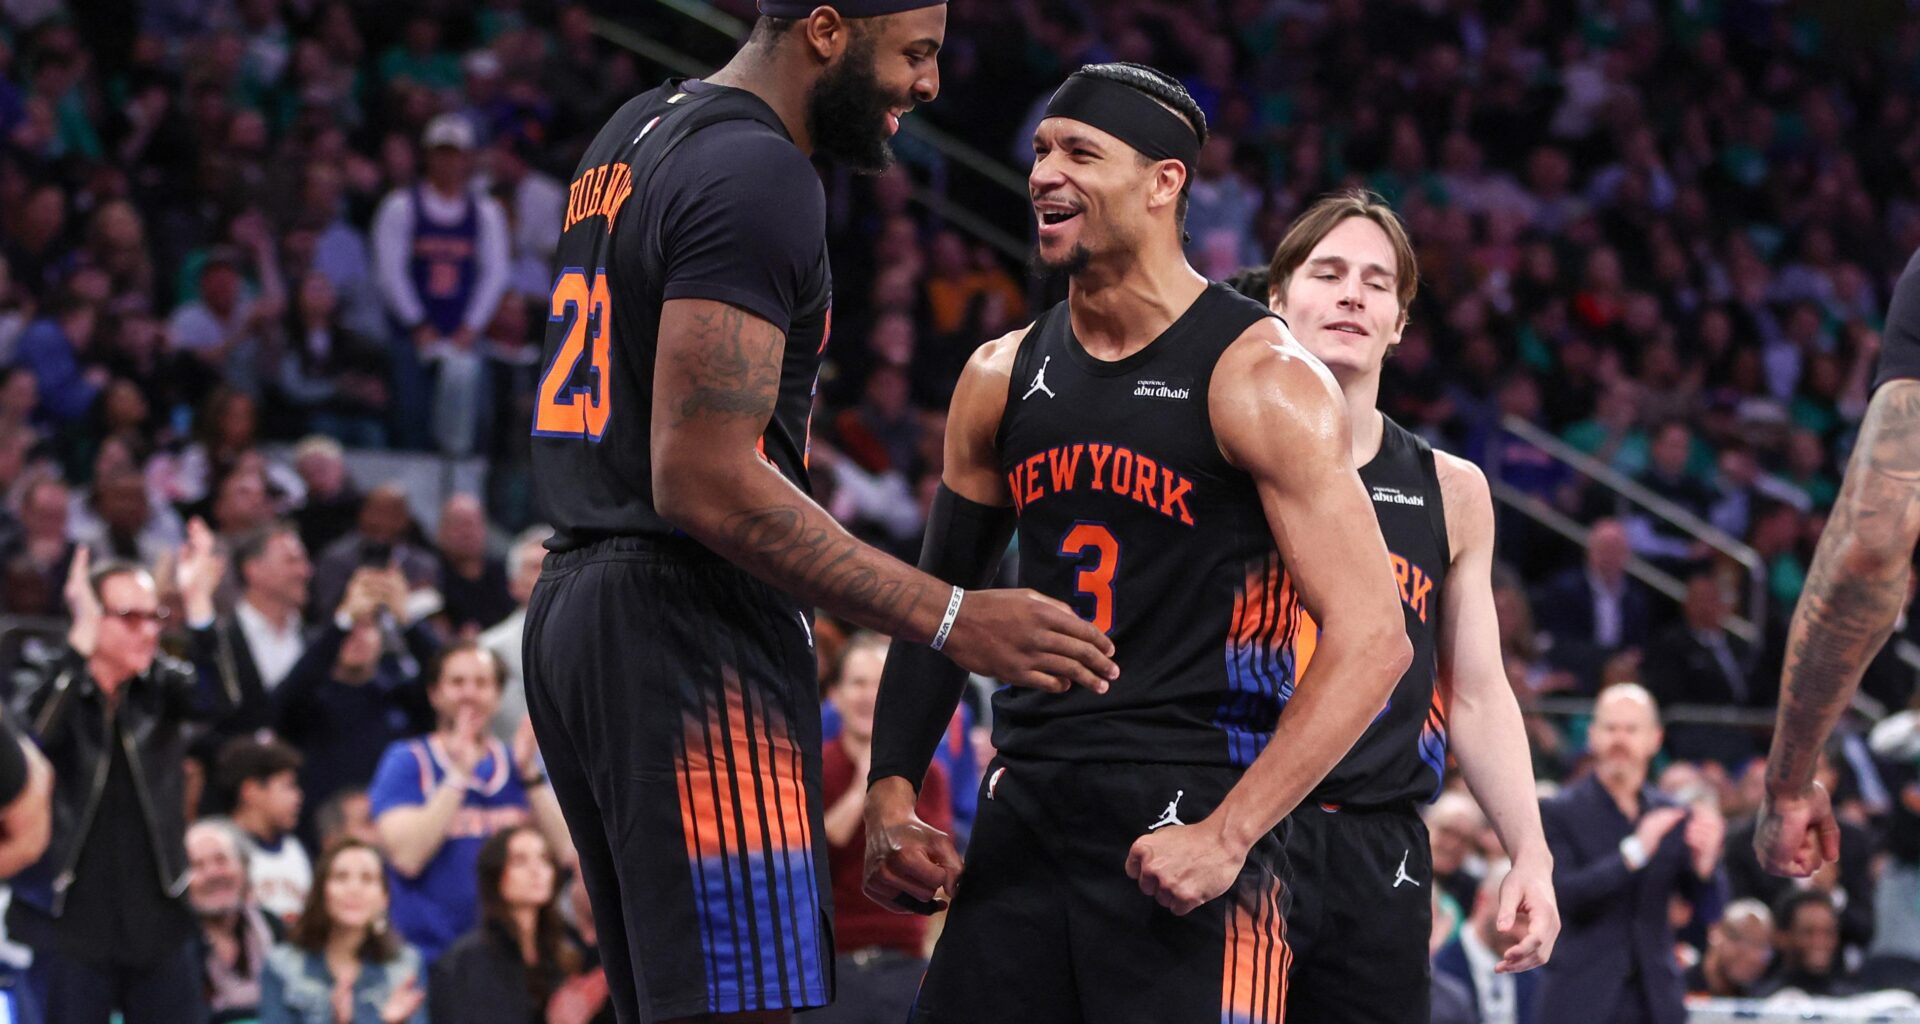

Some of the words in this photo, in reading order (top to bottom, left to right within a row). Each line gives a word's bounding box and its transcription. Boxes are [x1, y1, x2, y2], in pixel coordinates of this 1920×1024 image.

[531, 266, 613, 442] 23
[1133, 386, 1155, 396] abu
[1155, 386, 1190, 399] dhabi
[1008, 444, 1083, 517] NEW
[1088, 443, 1195, 527] YORK
[1372, 492, 1393, 502] abu
[1393, 494, 1424, 506] dhabi
[948, 587, 963, 617] ESS
[1056, 519, 1122, 638] 3
[1389, 551, 1433, 625] RK
